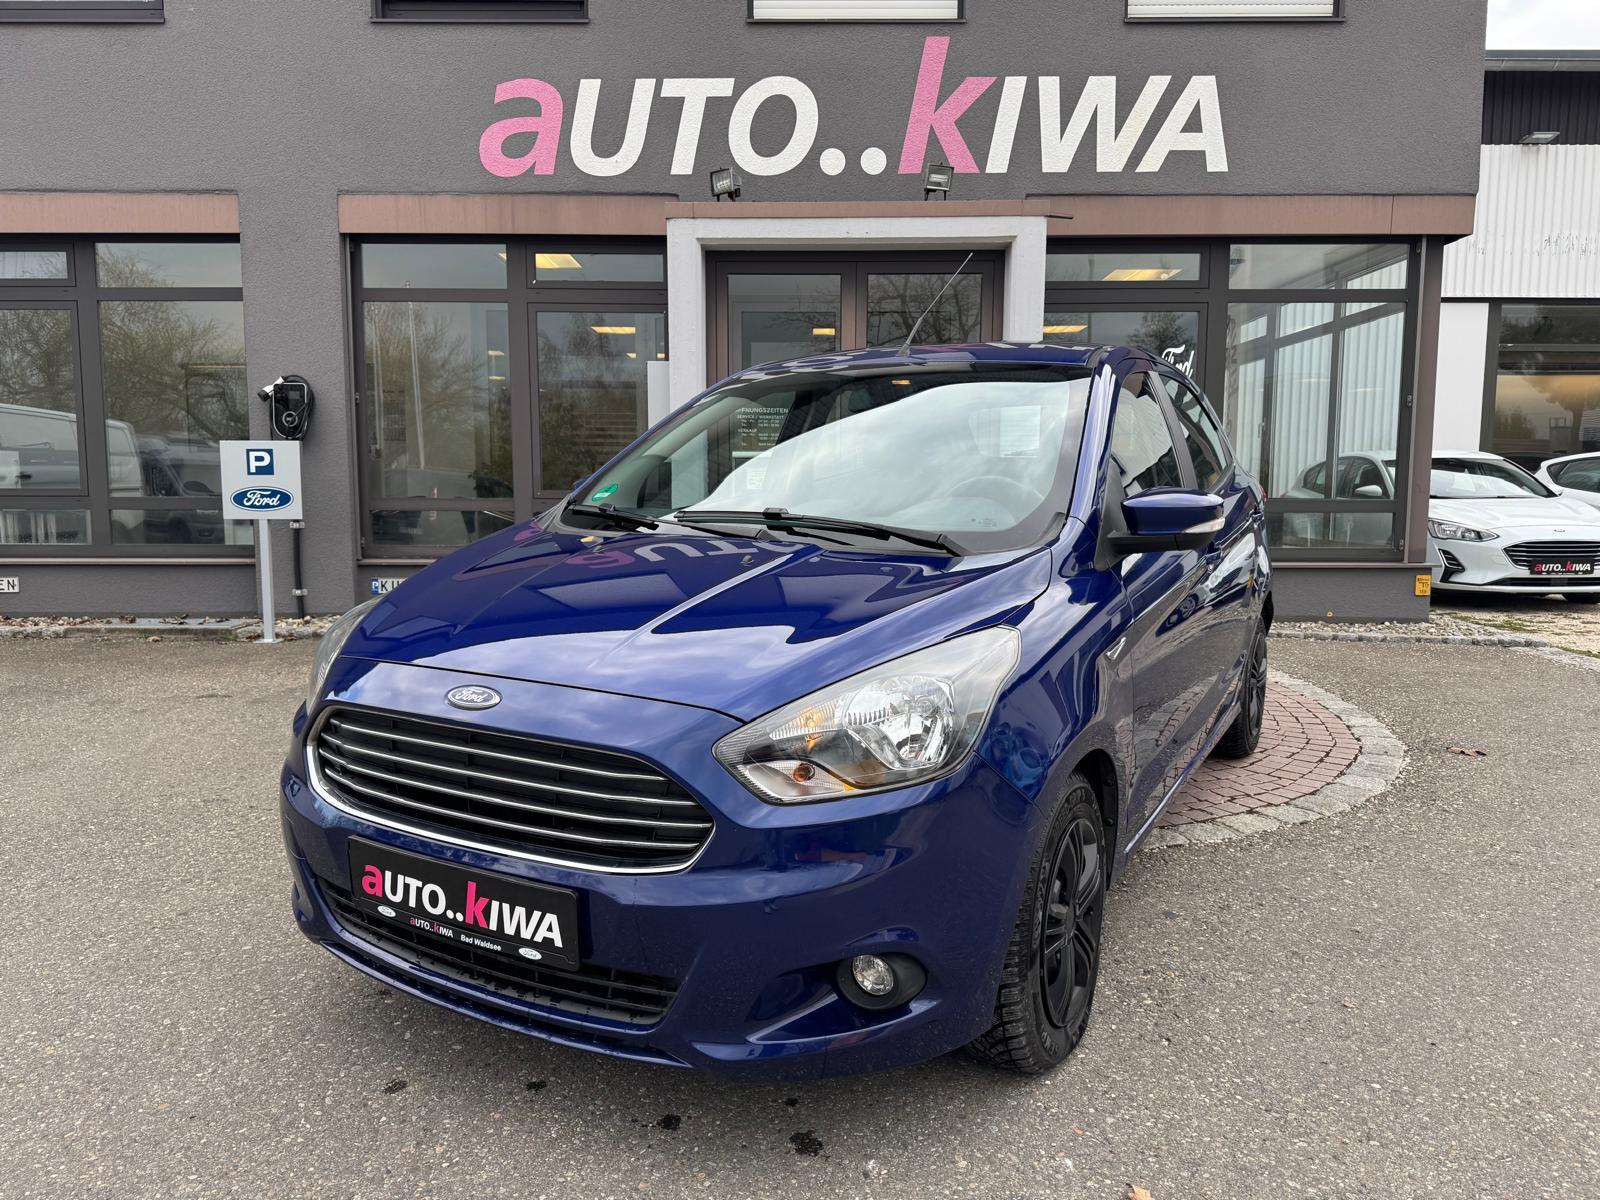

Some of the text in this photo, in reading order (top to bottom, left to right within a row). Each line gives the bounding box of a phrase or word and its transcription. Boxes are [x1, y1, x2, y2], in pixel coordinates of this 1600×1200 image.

[248, 451, 271, 473] P
[243, 489, 281, 506] Ford
[454, 685, 490, 703] Ford
[460, 934, 474, 945] Bad
[474, 937, 502, 952] Waldsee
